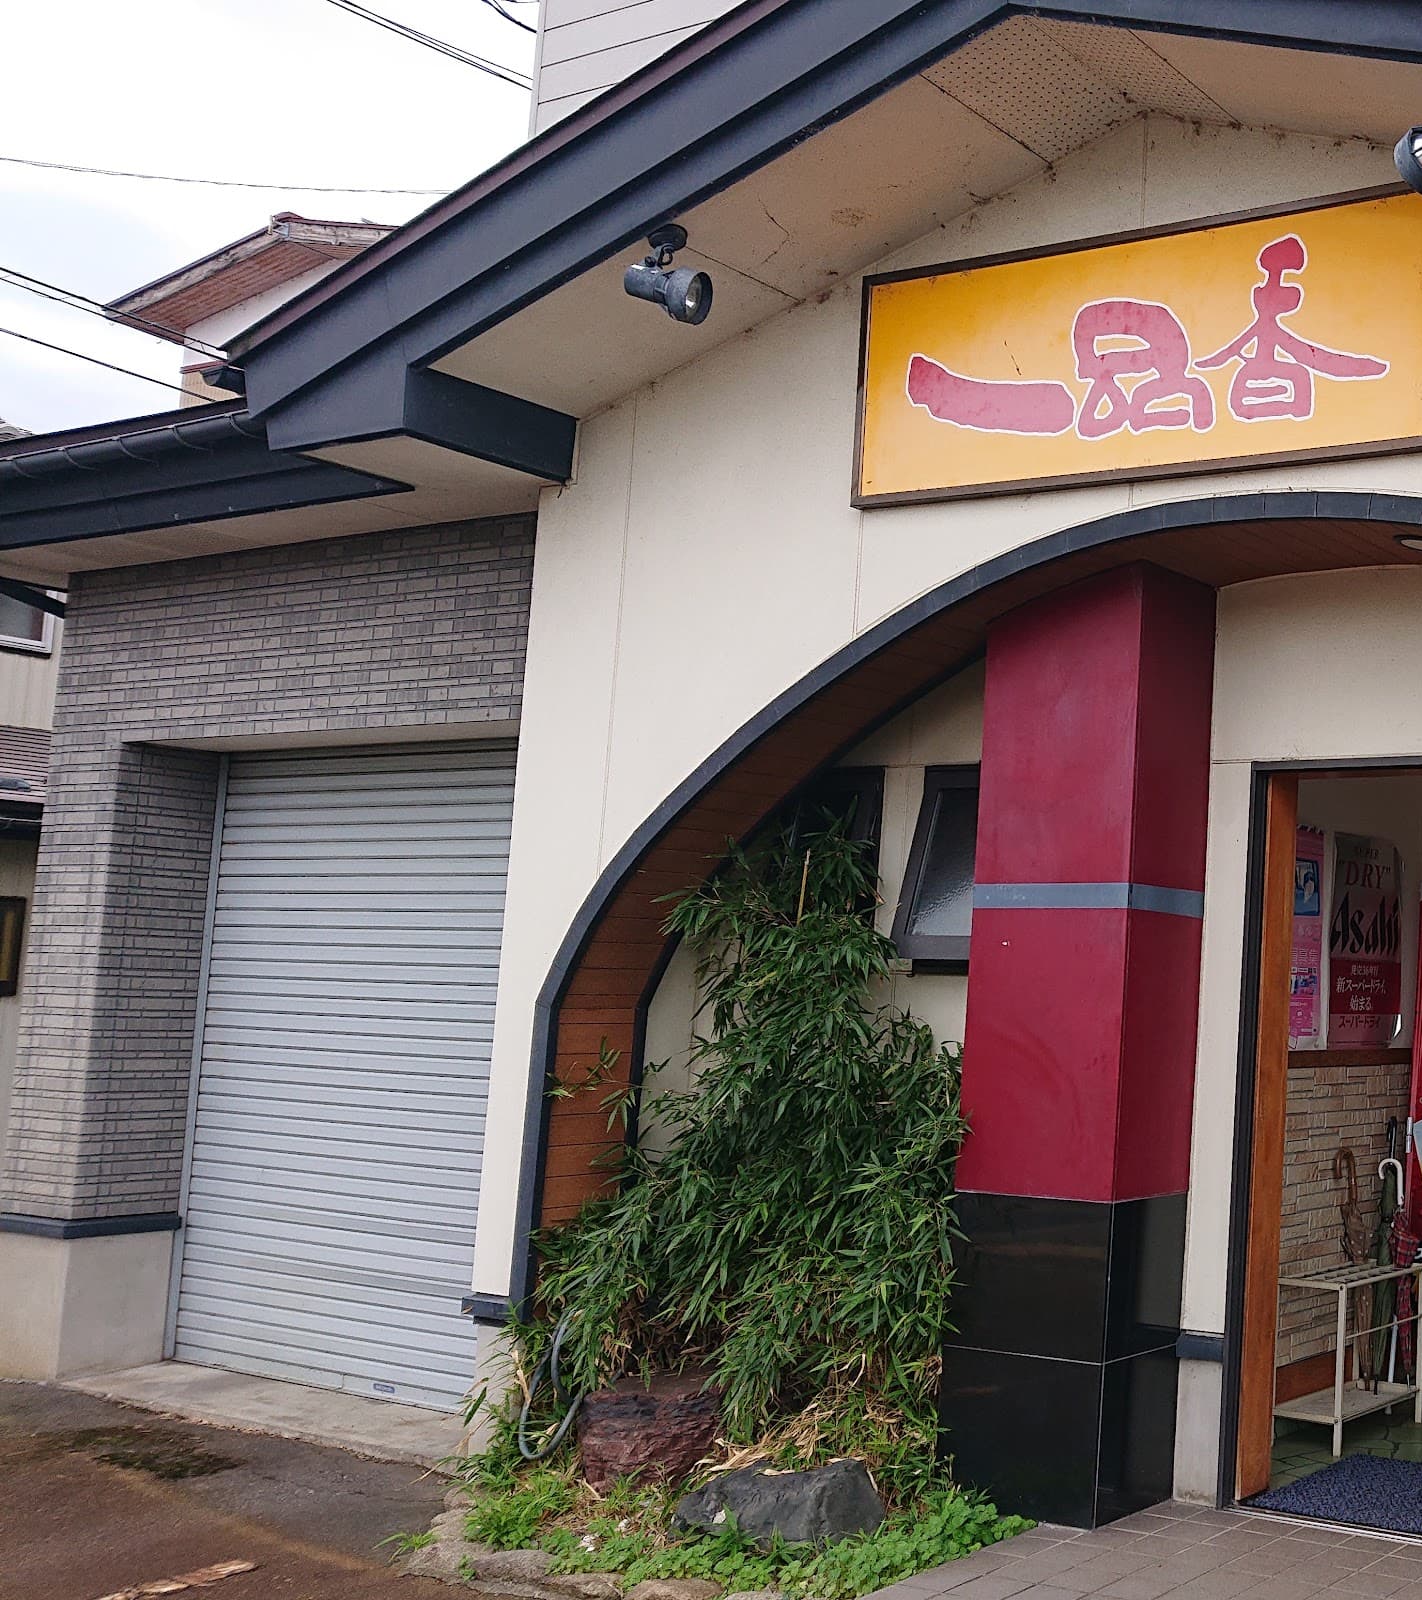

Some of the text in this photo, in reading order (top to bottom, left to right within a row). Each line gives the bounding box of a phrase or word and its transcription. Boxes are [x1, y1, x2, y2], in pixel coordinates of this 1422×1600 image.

[905, 232, 1391, 441] 一品香
[1329, 891, 1400, 954] Asahi
[1339, 1015, 1380, 1029] スーパードライ
[1350, 995, 1373, 1011] 始まる
